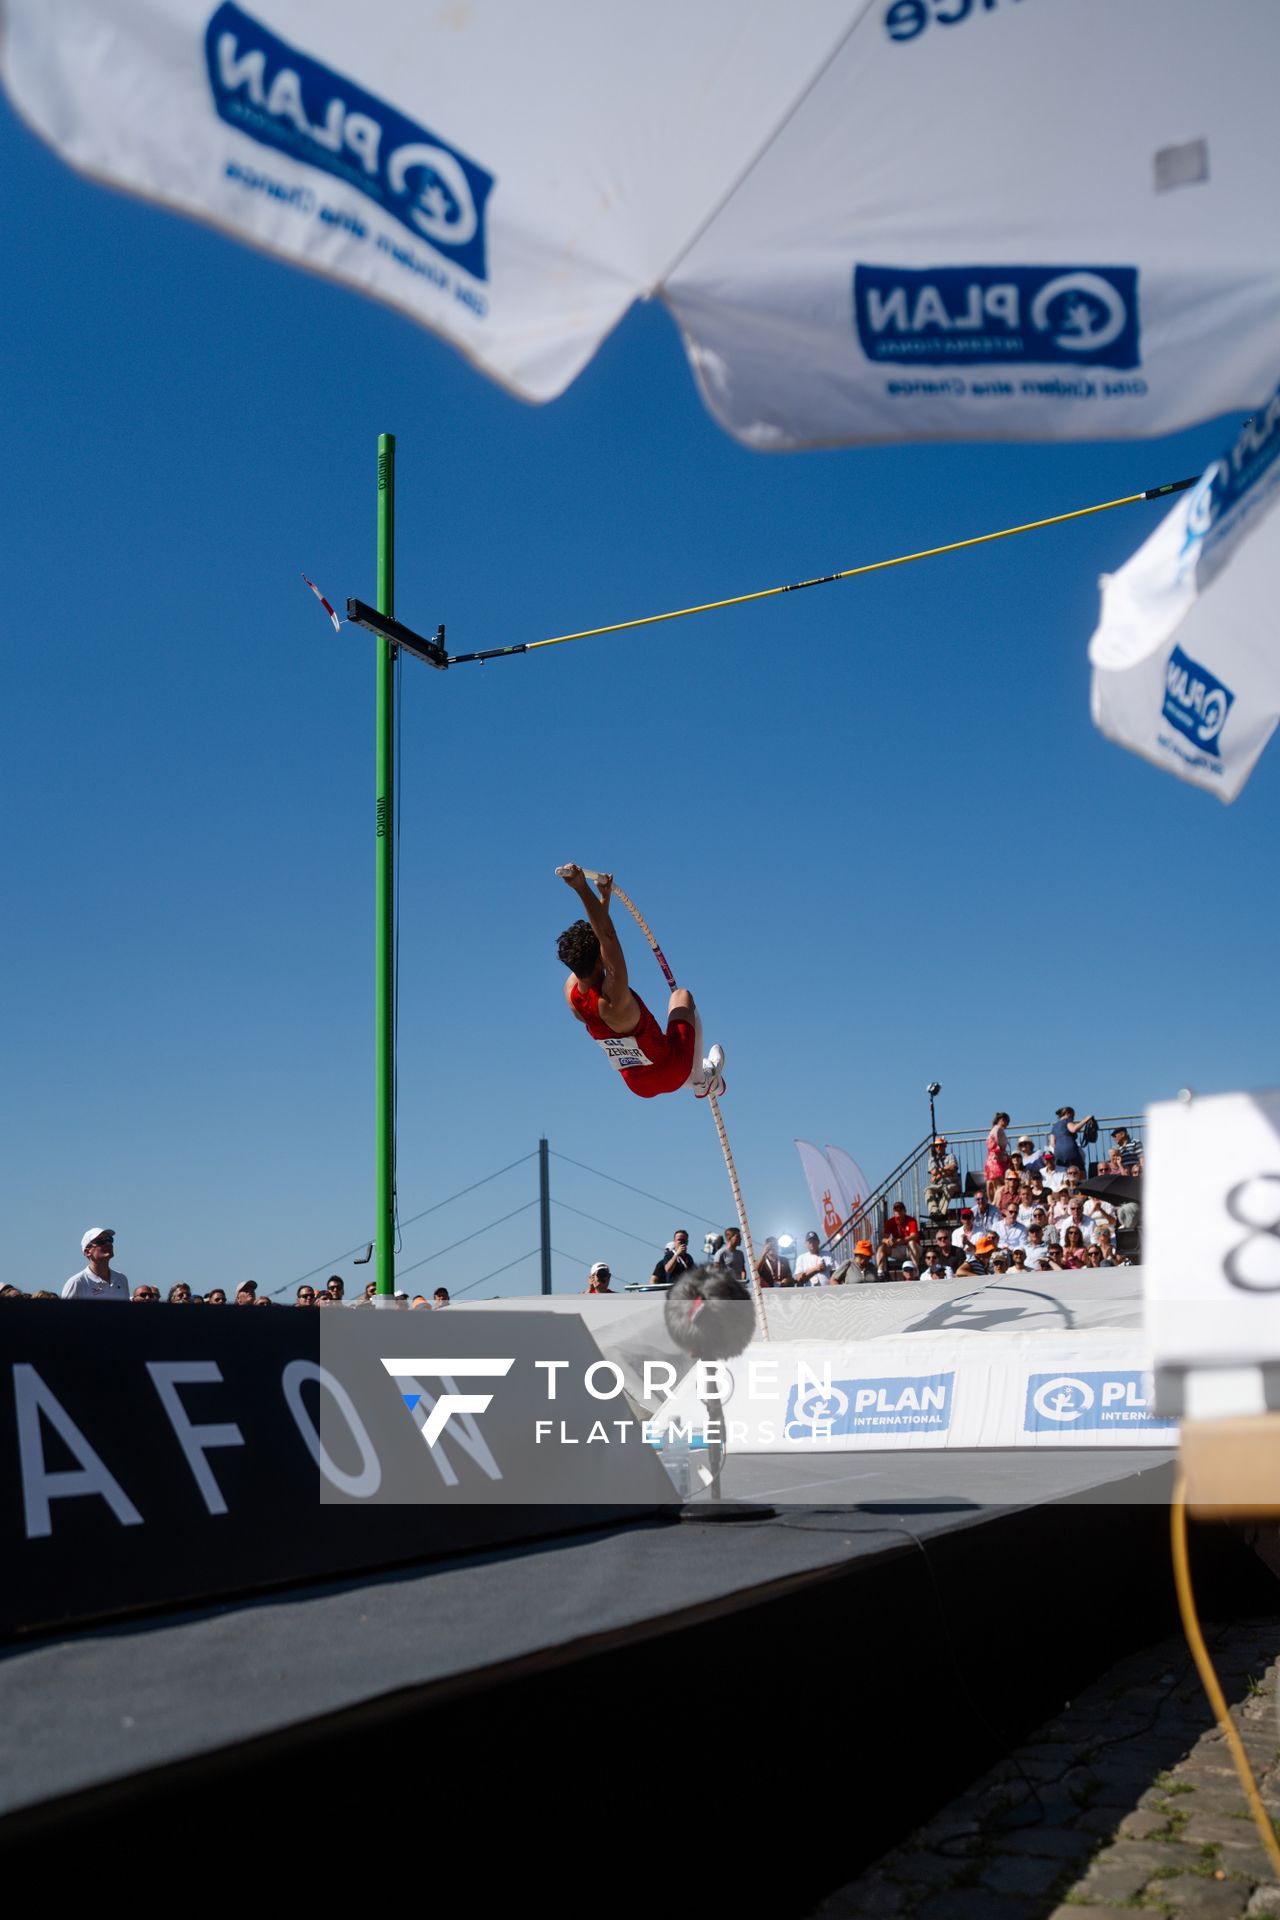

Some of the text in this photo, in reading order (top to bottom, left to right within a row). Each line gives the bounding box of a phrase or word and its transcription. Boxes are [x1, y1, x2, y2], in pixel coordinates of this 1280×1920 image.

[377, 452, 387, 491] VINDICO
[376, 796, 385, 837] VINDICO
[854, 1386, 945, 1413] PLAN
[854, 1415, 943, 1426] INTERNATIONAL
